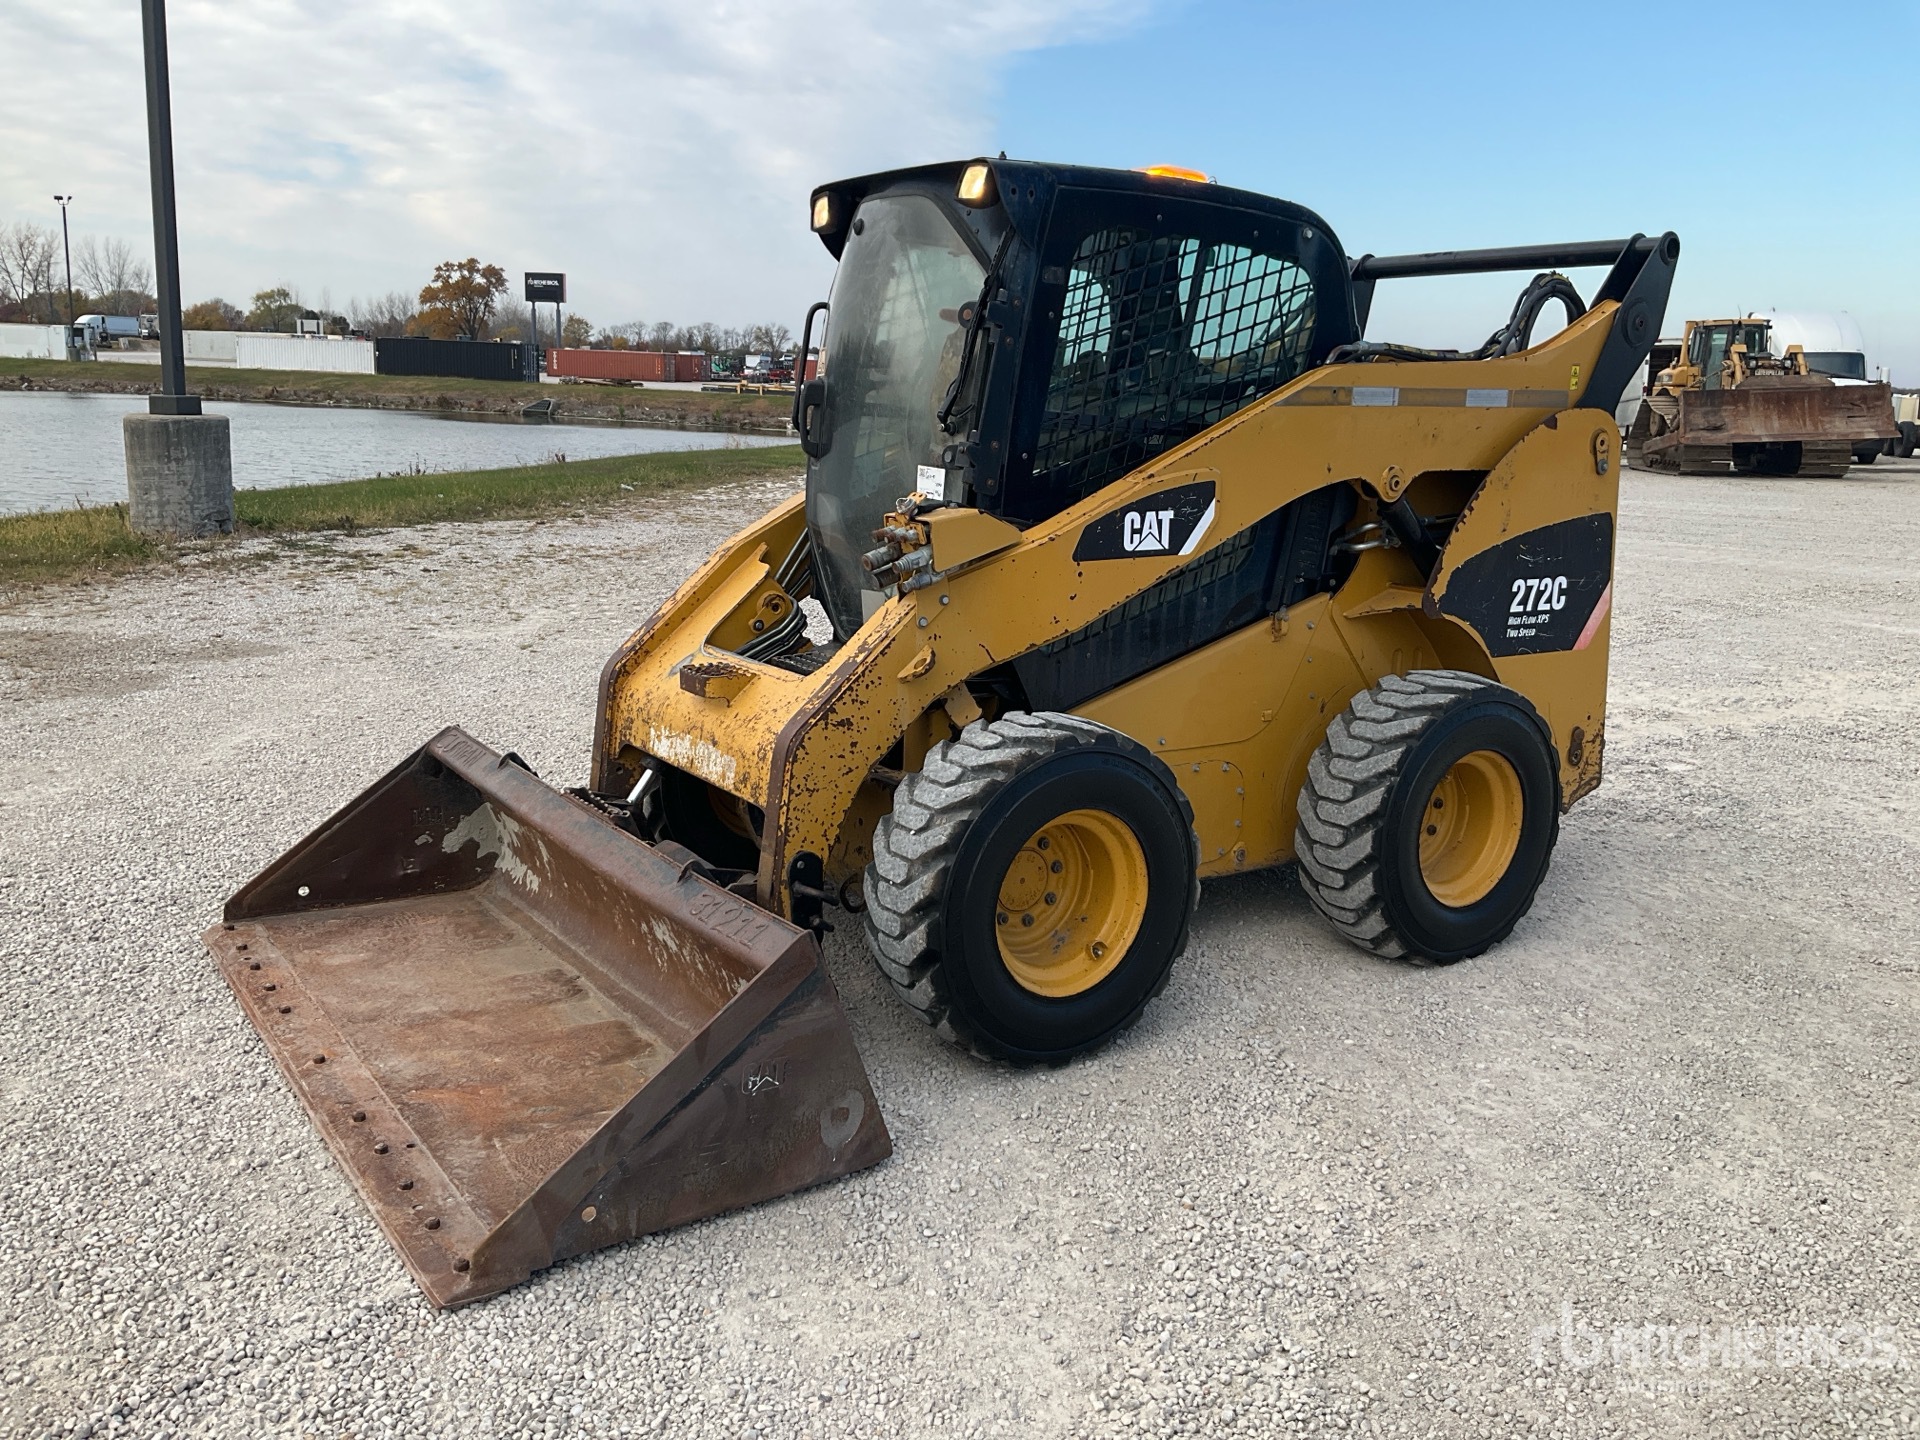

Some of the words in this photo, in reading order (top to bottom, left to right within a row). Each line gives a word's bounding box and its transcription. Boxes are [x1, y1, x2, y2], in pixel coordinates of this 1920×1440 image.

[1123, 510, 1174, 552] CAT
[1509, 575, 1568, 613] 272C
[1537, 614, 1550, 623] XPS
